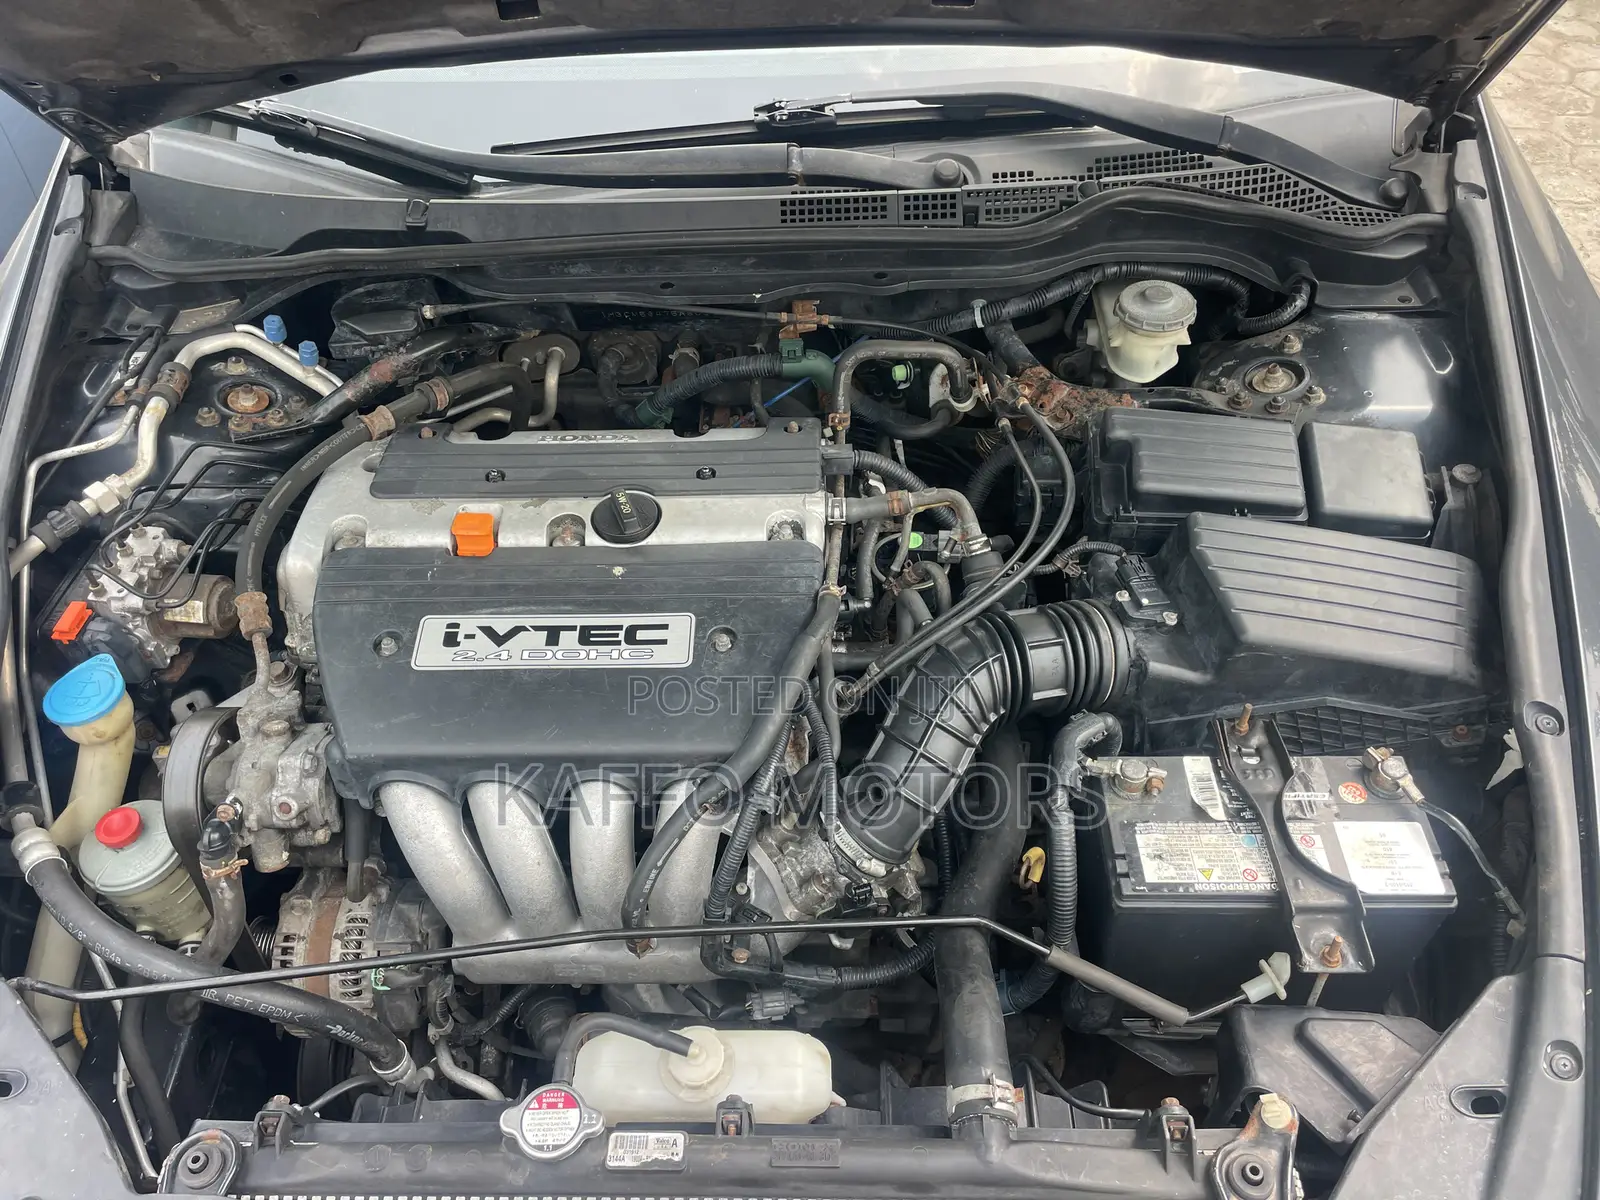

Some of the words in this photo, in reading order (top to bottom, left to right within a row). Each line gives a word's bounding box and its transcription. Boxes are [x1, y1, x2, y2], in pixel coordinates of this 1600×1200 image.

[537, 433, 639, 444] HONDA
[442, 622, 670, 648] i-VTEC
[451, 649, 512, 662] 2.4
[520, 648, 654, 661] DOHC
[94, 942, 121, 965] R134a
[671, 1138, 678, 1148] A
